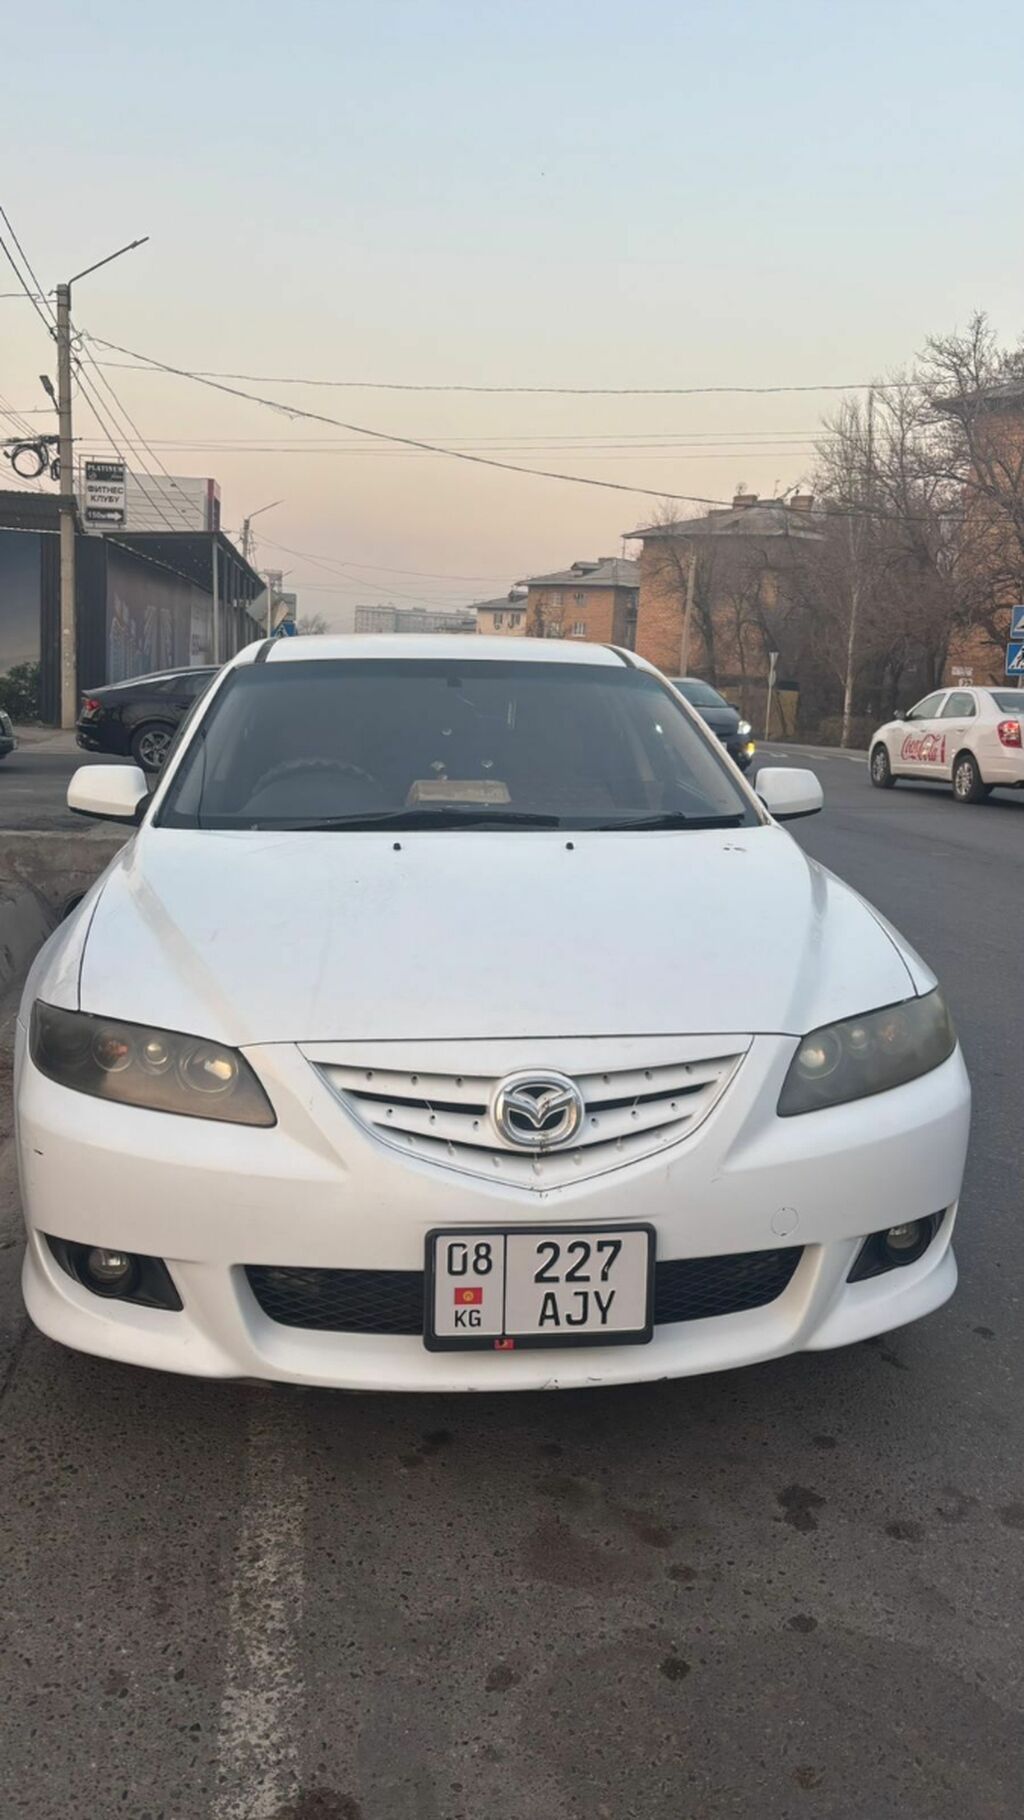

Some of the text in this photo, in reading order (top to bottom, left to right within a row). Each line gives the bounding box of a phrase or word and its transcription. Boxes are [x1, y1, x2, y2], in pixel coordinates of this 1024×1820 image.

[87, 485, 124, 494] ФИТНЕС
[447, 1242, 493, 1276] 08
[534, 1239, 622, 1283] 227
[454, 1309, 482, 1328] KG
[538, 1290, 616, 1327] AJY
